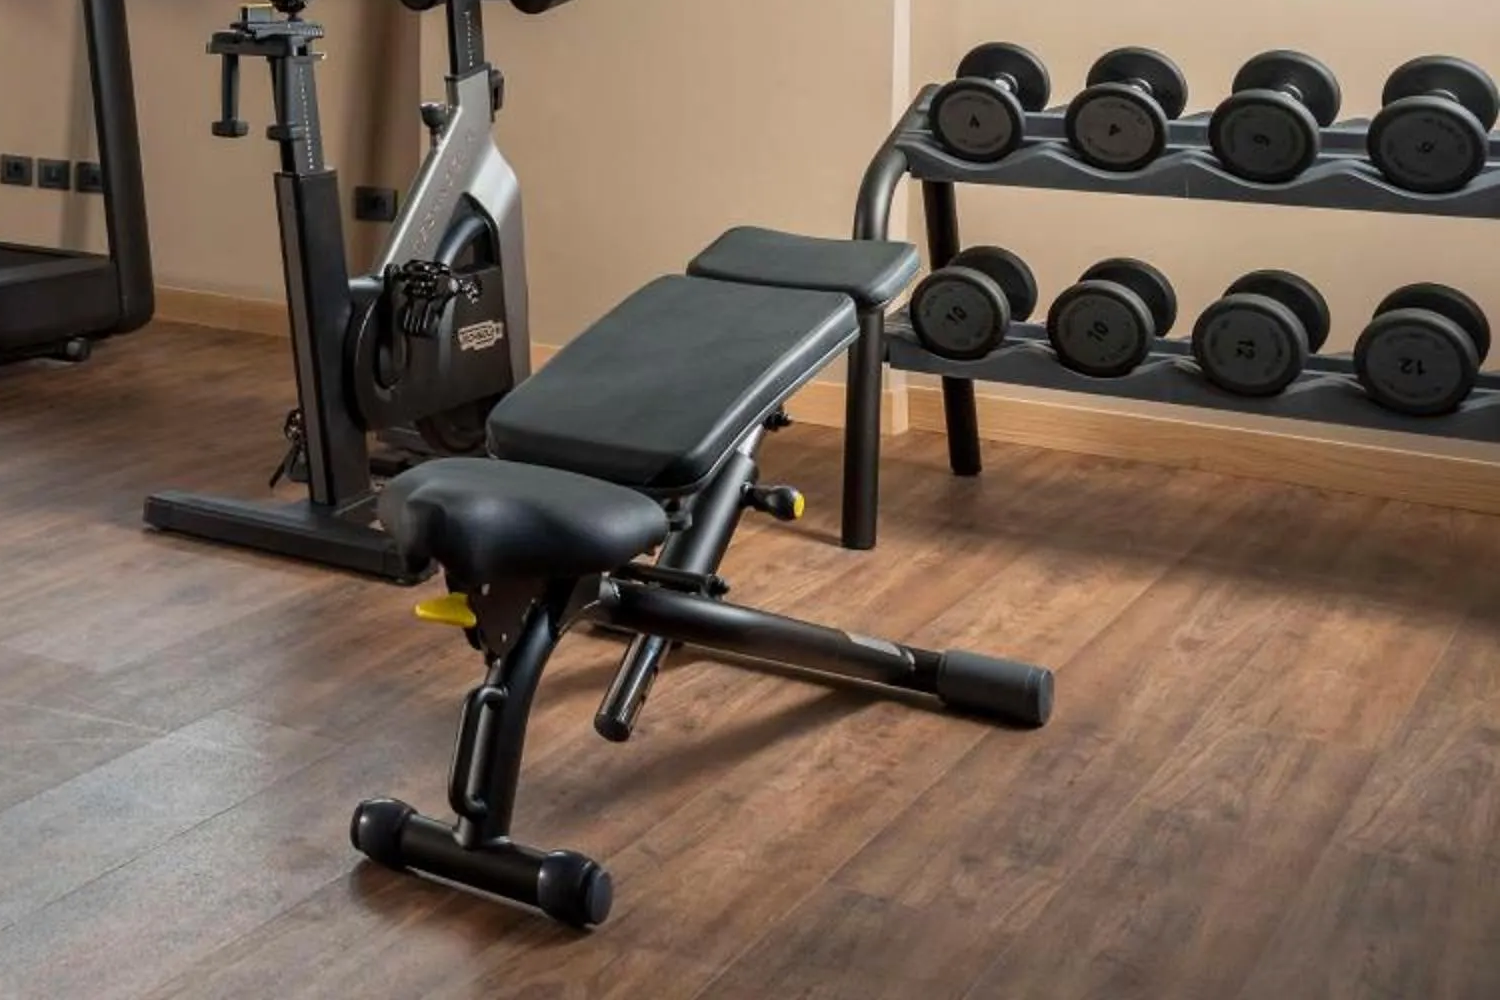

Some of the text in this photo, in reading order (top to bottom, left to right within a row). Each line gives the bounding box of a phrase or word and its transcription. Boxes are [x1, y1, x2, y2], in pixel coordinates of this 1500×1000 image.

[946, 305, 968, 324] 10
[1086, 320, 1110, 343] 10
[1399, 356, 1427, 377] 12
